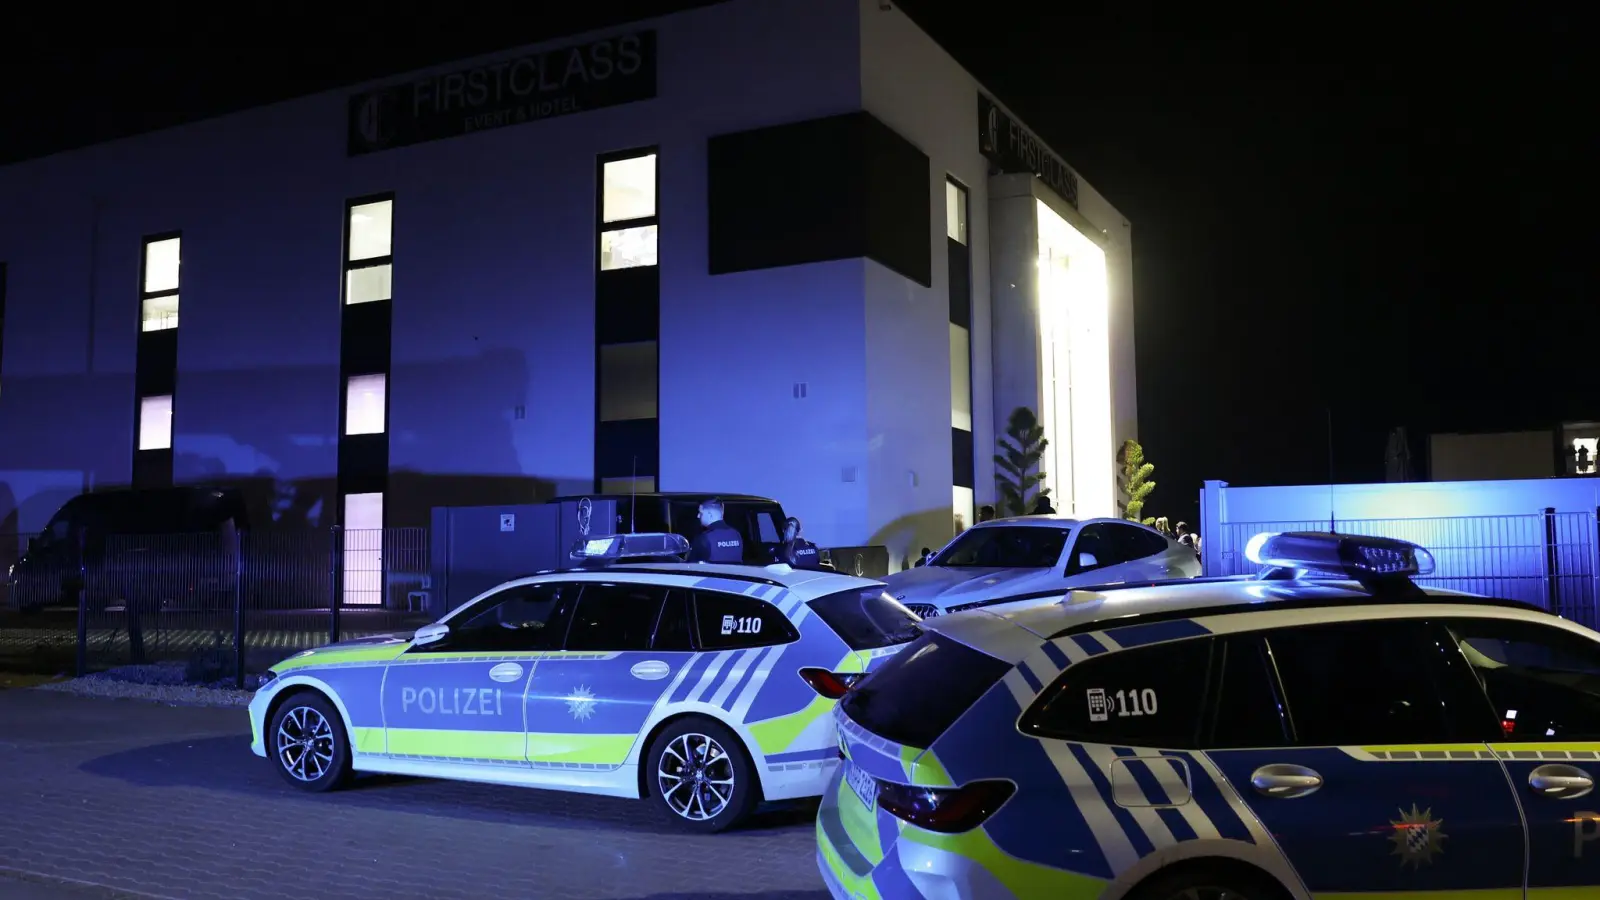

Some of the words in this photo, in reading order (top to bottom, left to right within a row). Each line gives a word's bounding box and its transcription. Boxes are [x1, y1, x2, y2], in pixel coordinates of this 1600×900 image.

[413, 34, 642, 118] FIRSTCLASS
[464, 108, 511, 132] EVENT
[515, 104, 528, 118] &
[530, 94, 582, 118] HOTEL
[717, 540, 739, 548] POLIZEI
[737, 616, 762, 634] 110
[402, 687, 503, 716] POLIZEI
[1116, 687, 1158, 718] 110
